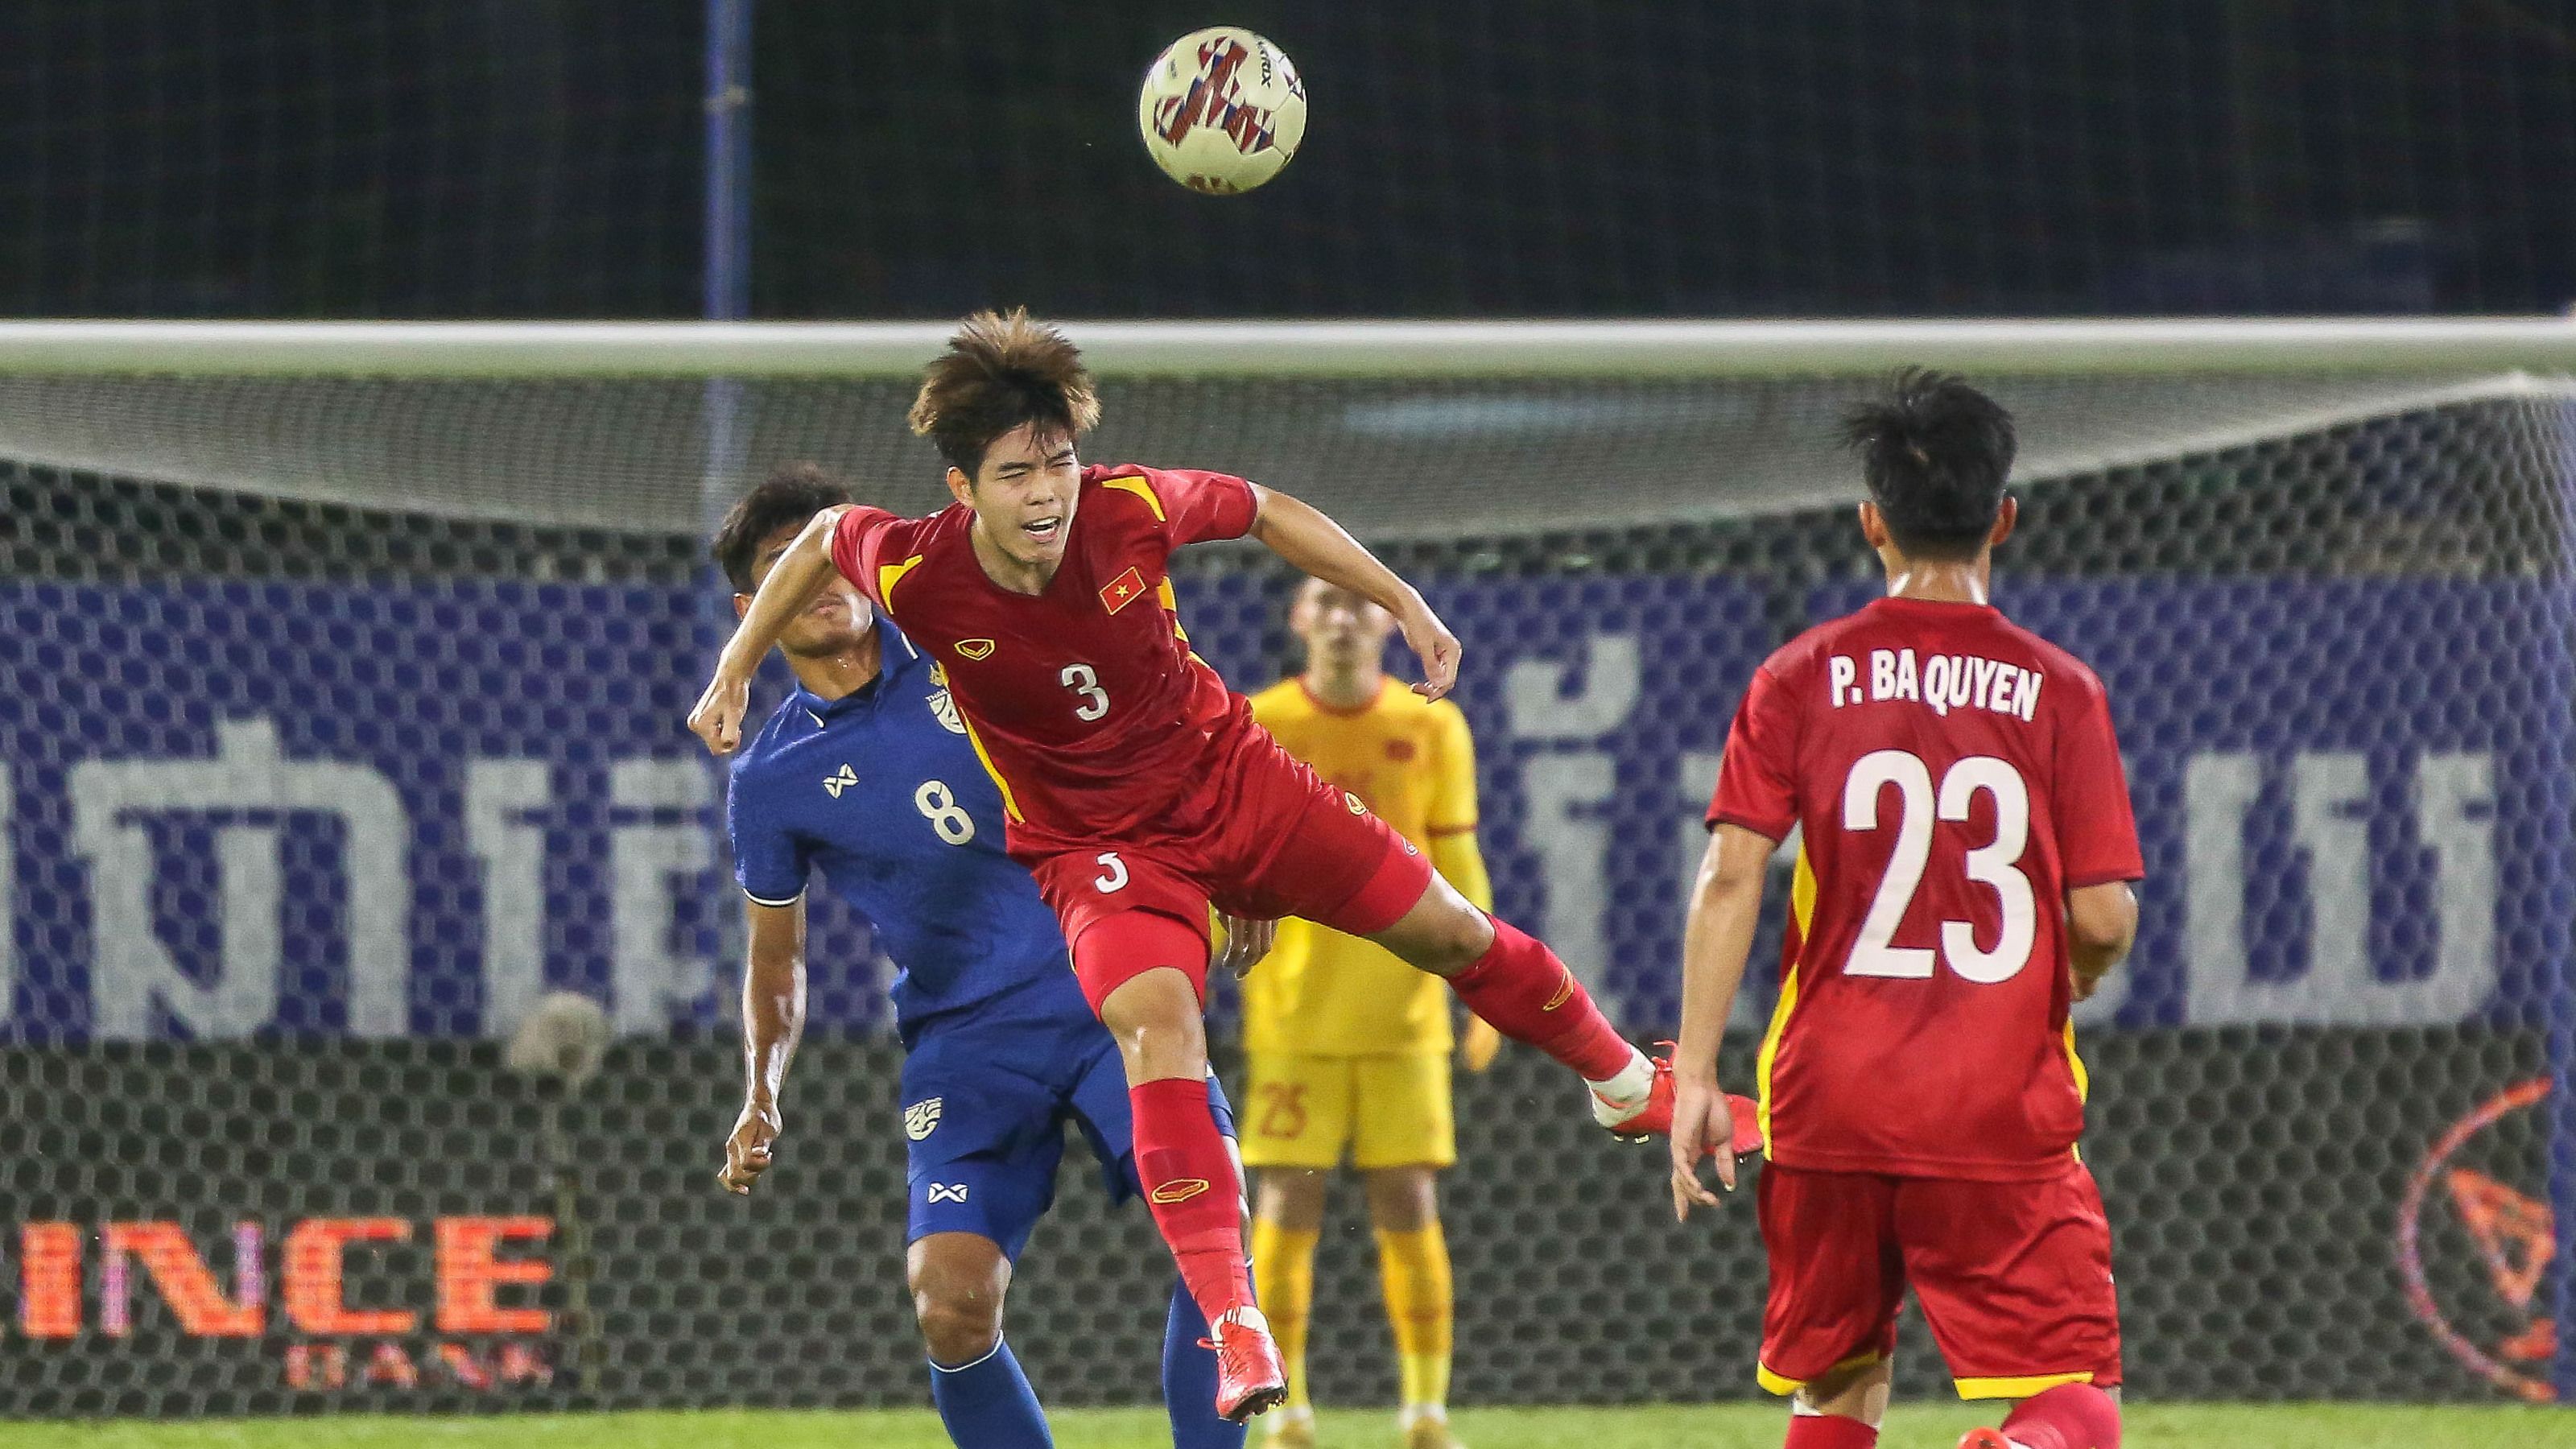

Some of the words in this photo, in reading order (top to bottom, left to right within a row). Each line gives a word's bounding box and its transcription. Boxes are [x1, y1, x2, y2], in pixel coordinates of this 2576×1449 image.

[1061, 663, 1110, 721] 3
[1829, 654, 1864, 708] P.
[1869, 647, 1920, 702] BA
[1923, 653, 2044, 723] QUYEN
[914, 778, 976, 845] 8
[1842, 748, 2038, 985] 23
[19, 1217, 554, 1337] INCE
